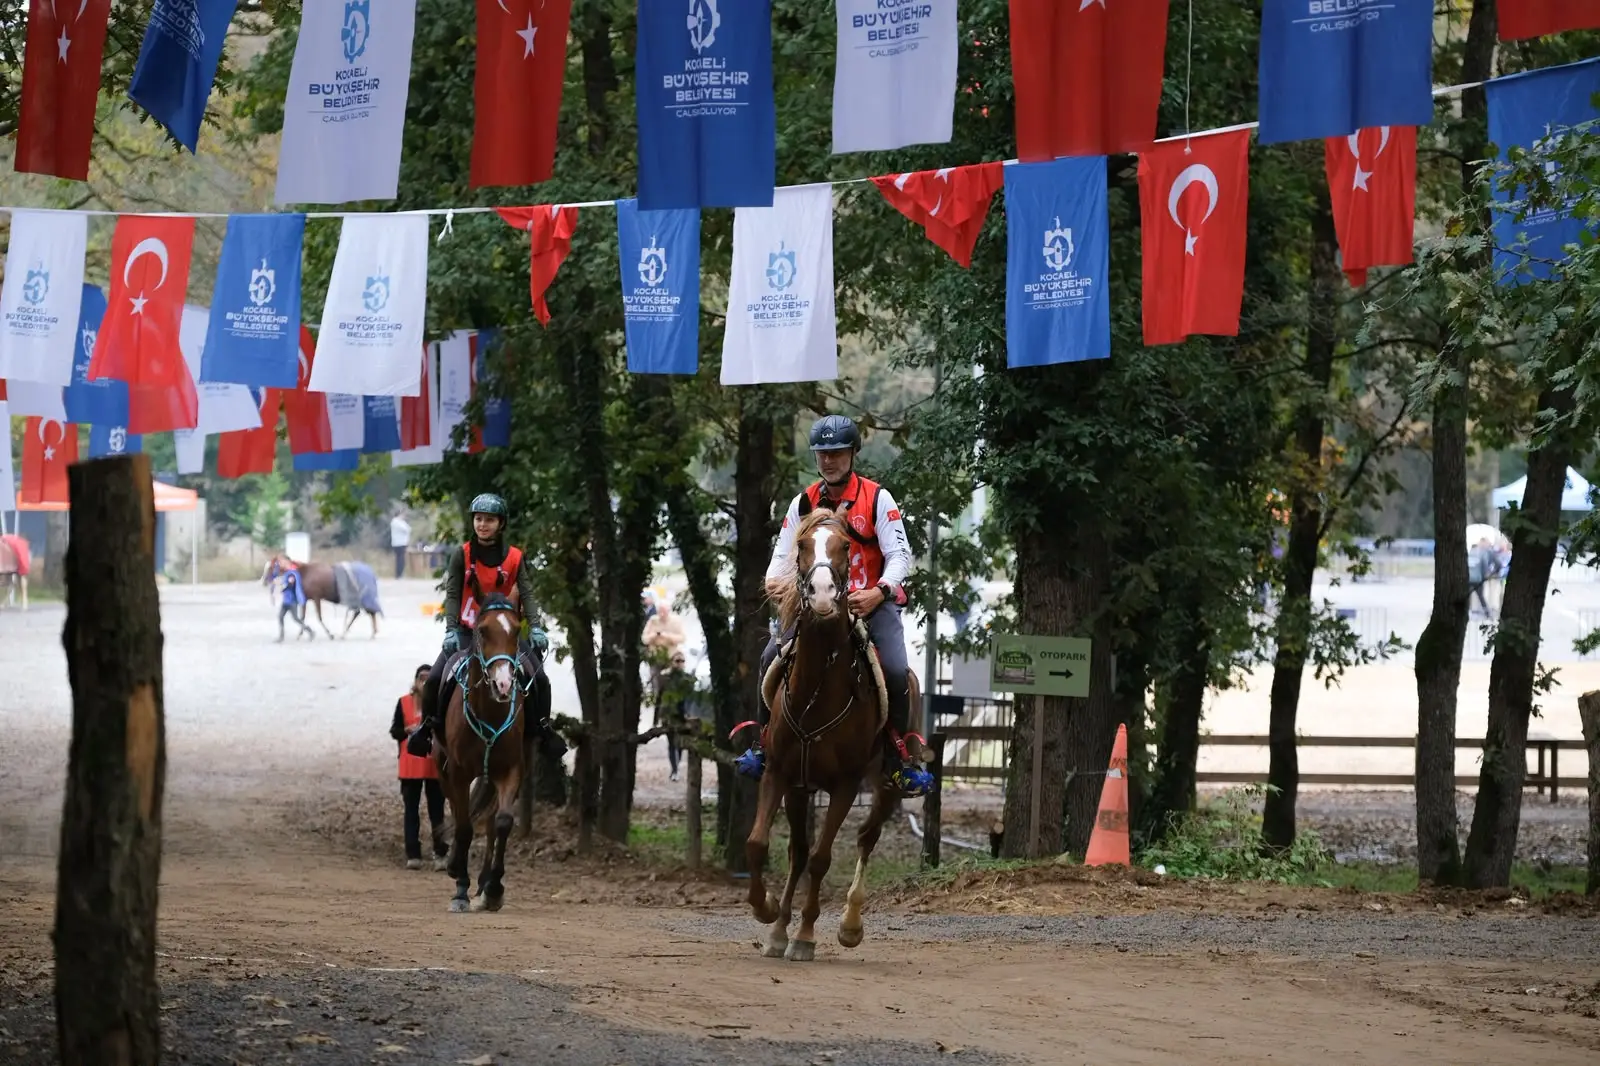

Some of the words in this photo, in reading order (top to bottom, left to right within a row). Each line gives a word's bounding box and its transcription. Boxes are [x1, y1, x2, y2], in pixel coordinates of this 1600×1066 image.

[1040, 270, 1078, 281] KOCAELİ
[1024, 277, 1092, 293] BÜYÜKŞEHİR
[633, 287, 669, 295] KOCAELİ
[1033, 288, 1084, 301] BELEDİYESİ
[761, 293, 798, 302] KOCAELİ
[243, 306, 277, 315] KOCAELİ
[1040, 650, 1087, 661] OTOPARK
